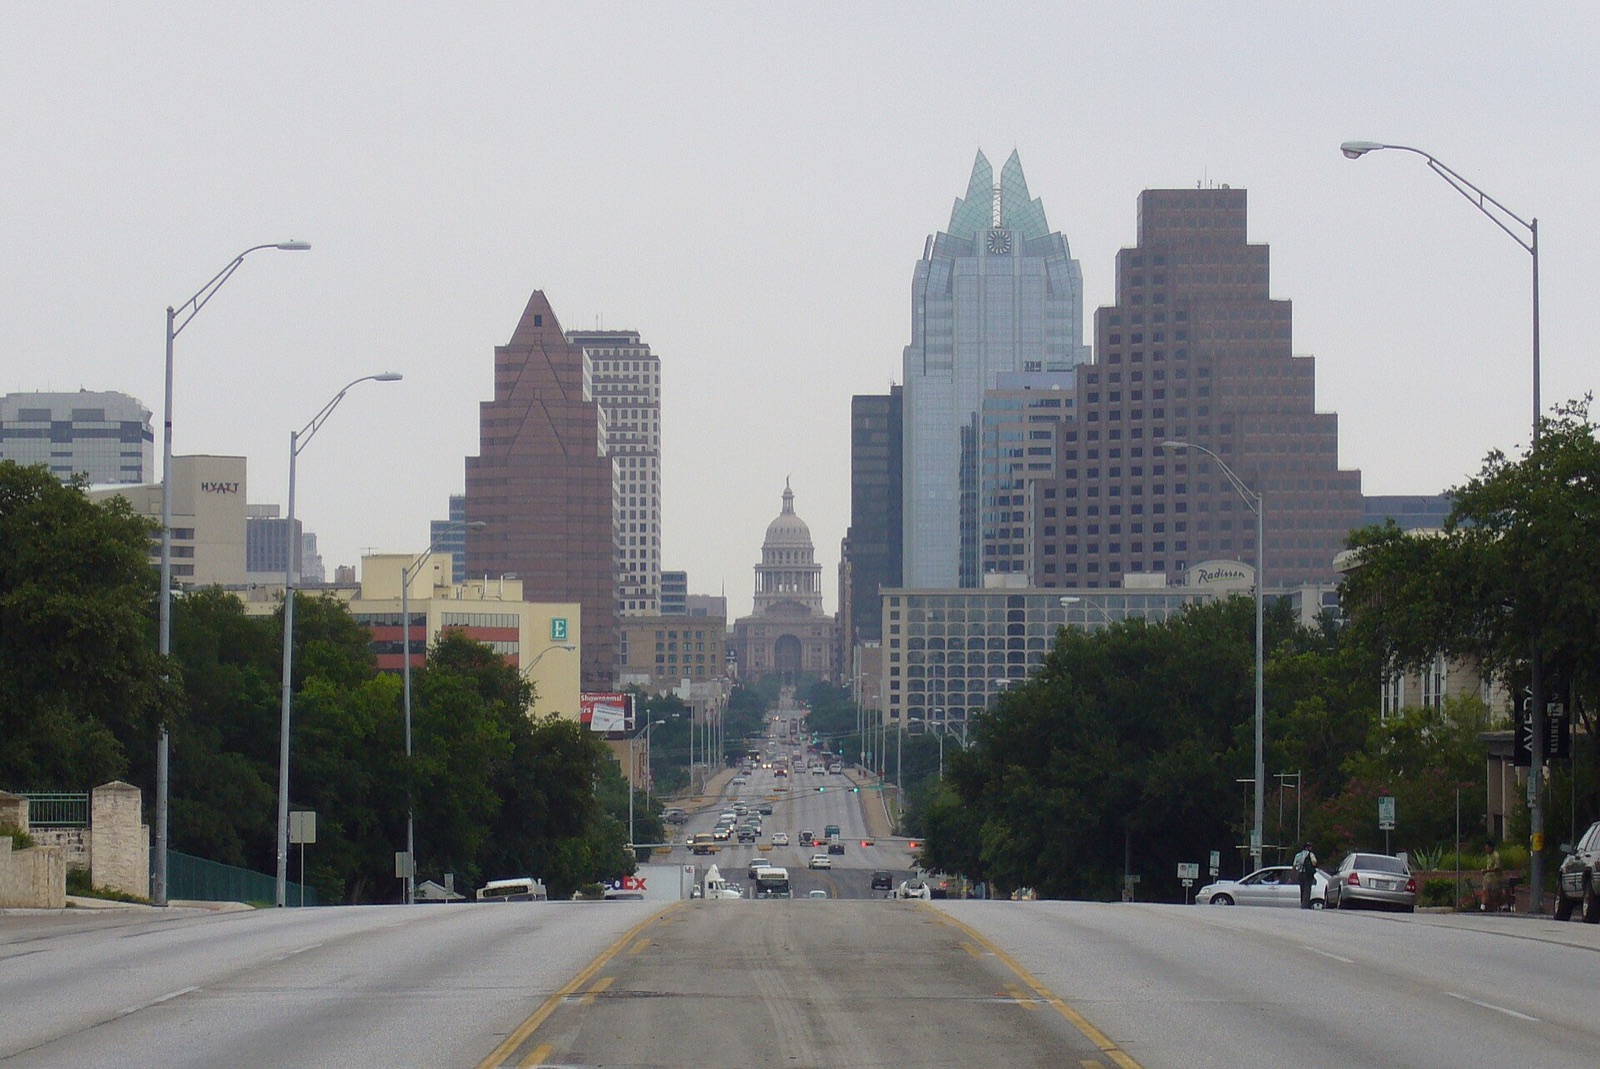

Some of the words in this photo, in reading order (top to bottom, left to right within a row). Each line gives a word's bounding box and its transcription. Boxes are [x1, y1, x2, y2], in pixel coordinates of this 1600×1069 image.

[201, 482, 240, 494] HYATT
[1198, 567, 1246, 584] Radisson
[555, 620, 565, 638] E
